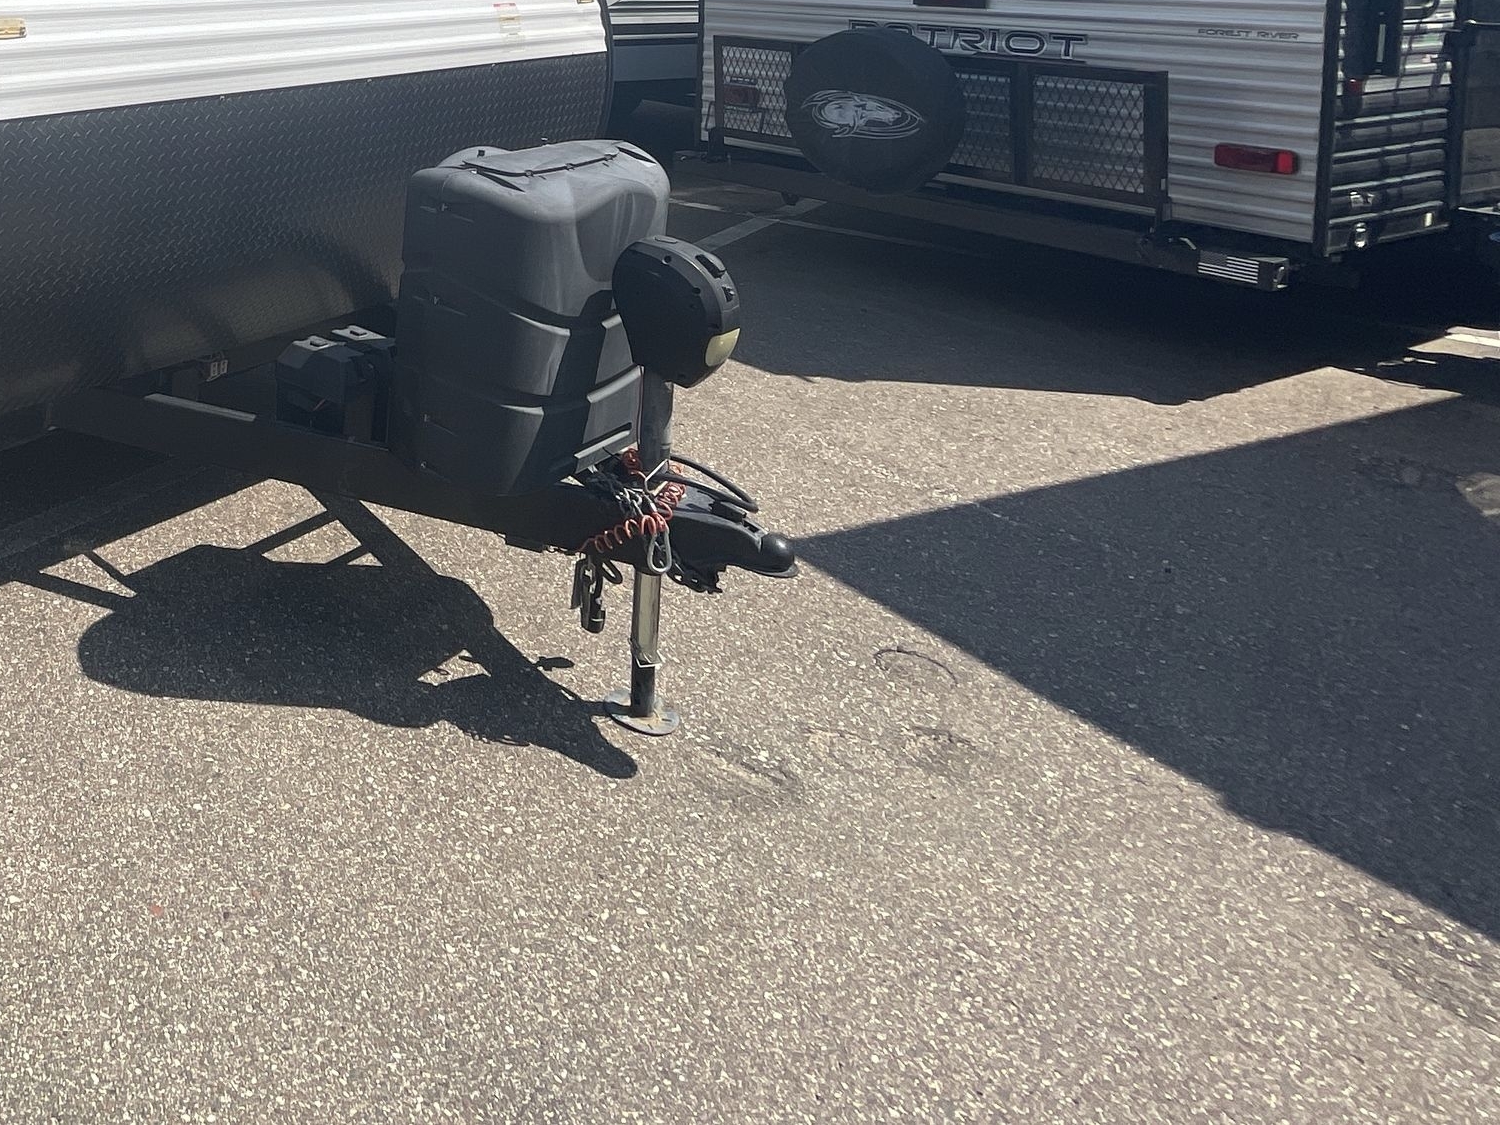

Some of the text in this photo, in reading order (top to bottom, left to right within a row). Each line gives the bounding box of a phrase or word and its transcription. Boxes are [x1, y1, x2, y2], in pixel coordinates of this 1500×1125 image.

[849, 20, 1088, 62] TRIOT
[1198, 28, 1299, 41] FOREST RIVER
